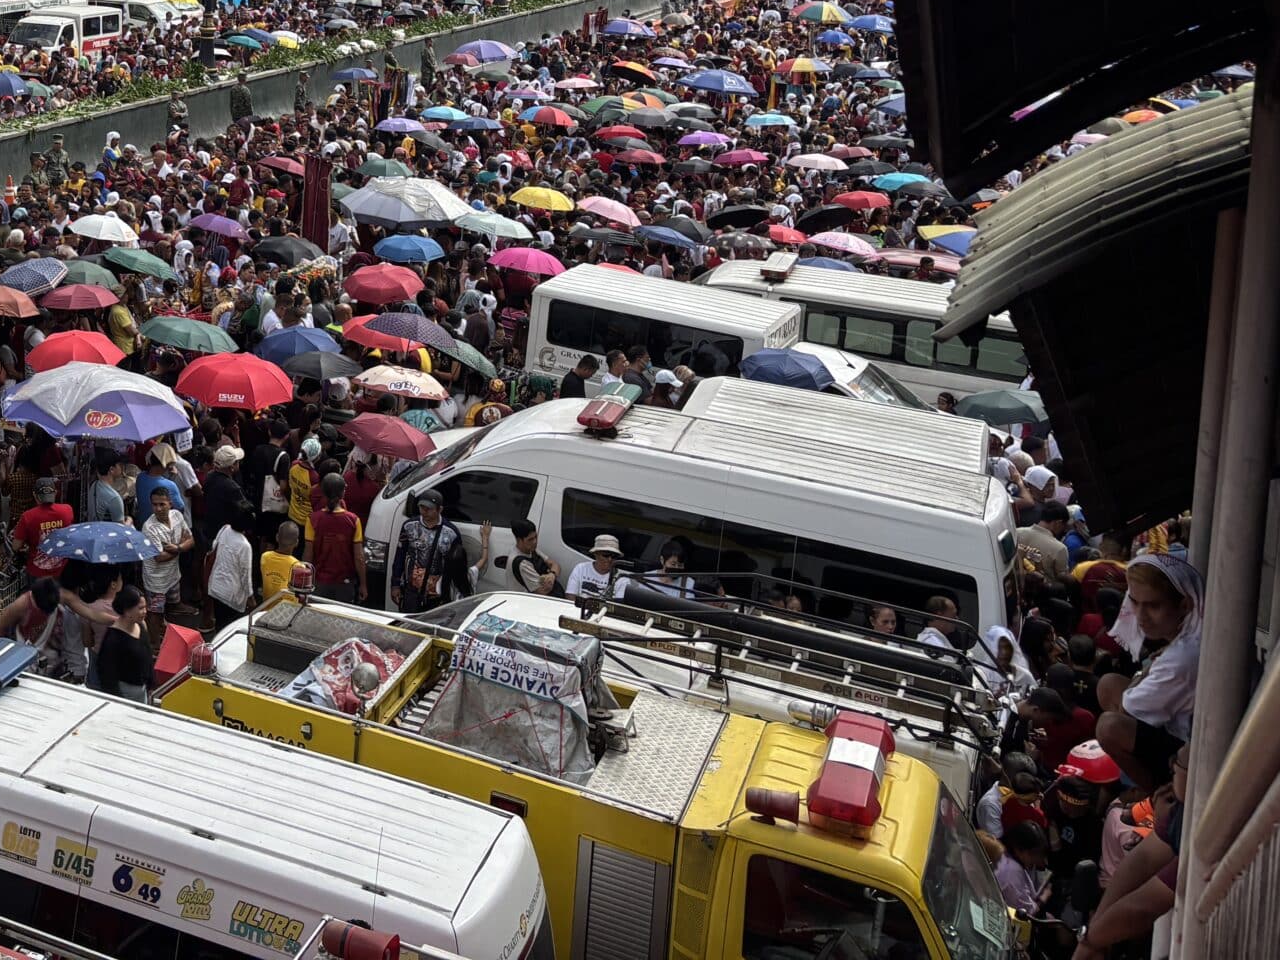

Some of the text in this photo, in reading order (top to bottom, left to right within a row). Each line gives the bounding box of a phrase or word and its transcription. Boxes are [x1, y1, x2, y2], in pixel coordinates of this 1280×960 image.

[484, 655, 530, 674] SUPPORT
[531, 667, 555, 681] LIFE
[863, 692, 886, 704] PLDT
[19, 825, 41, 840] LOTTO
[52, 848, 95, 878] 6/45
[176, 886, 215, 906] GRAND
[232, 900, 306, 941] ULTRA
